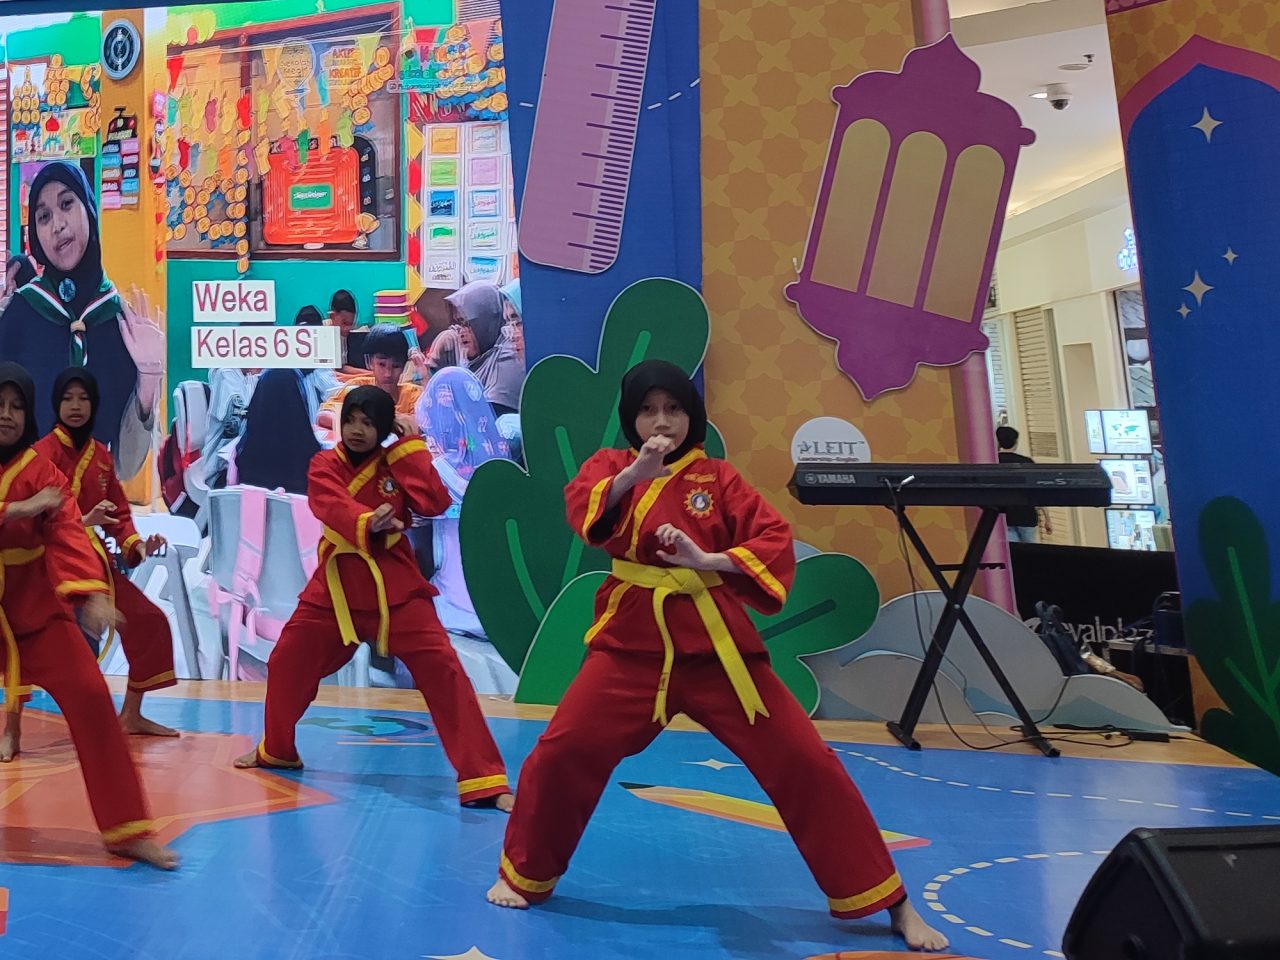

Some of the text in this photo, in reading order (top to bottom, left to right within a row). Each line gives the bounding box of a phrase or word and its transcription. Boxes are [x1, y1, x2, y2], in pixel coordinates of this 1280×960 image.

[194, 283, 269, 312] Weka
[197, 329, 268, 358] Kelas
[273, 328, 289, 358] 6
[816, 473, 857, 484] YAMAHA
